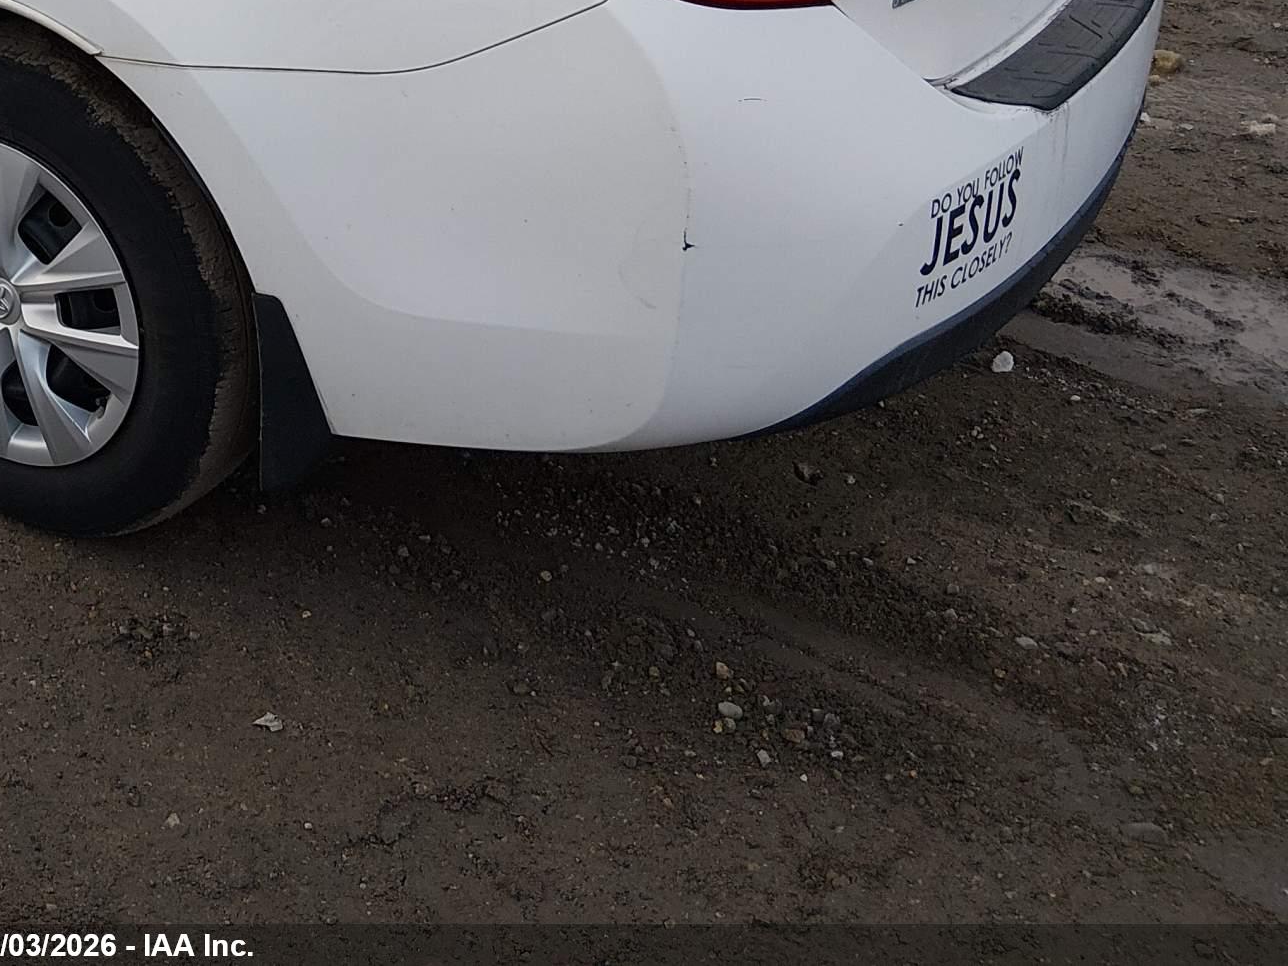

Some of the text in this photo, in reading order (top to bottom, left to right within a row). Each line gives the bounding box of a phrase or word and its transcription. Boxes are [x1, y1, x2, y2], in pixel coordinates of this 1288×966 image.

[930, 146, 1024, 219] DO YOU FOLLOW
[919, 168, 1021, 276] JESUS
[915, 231, 1013, 308] THIS CLOSELY?
